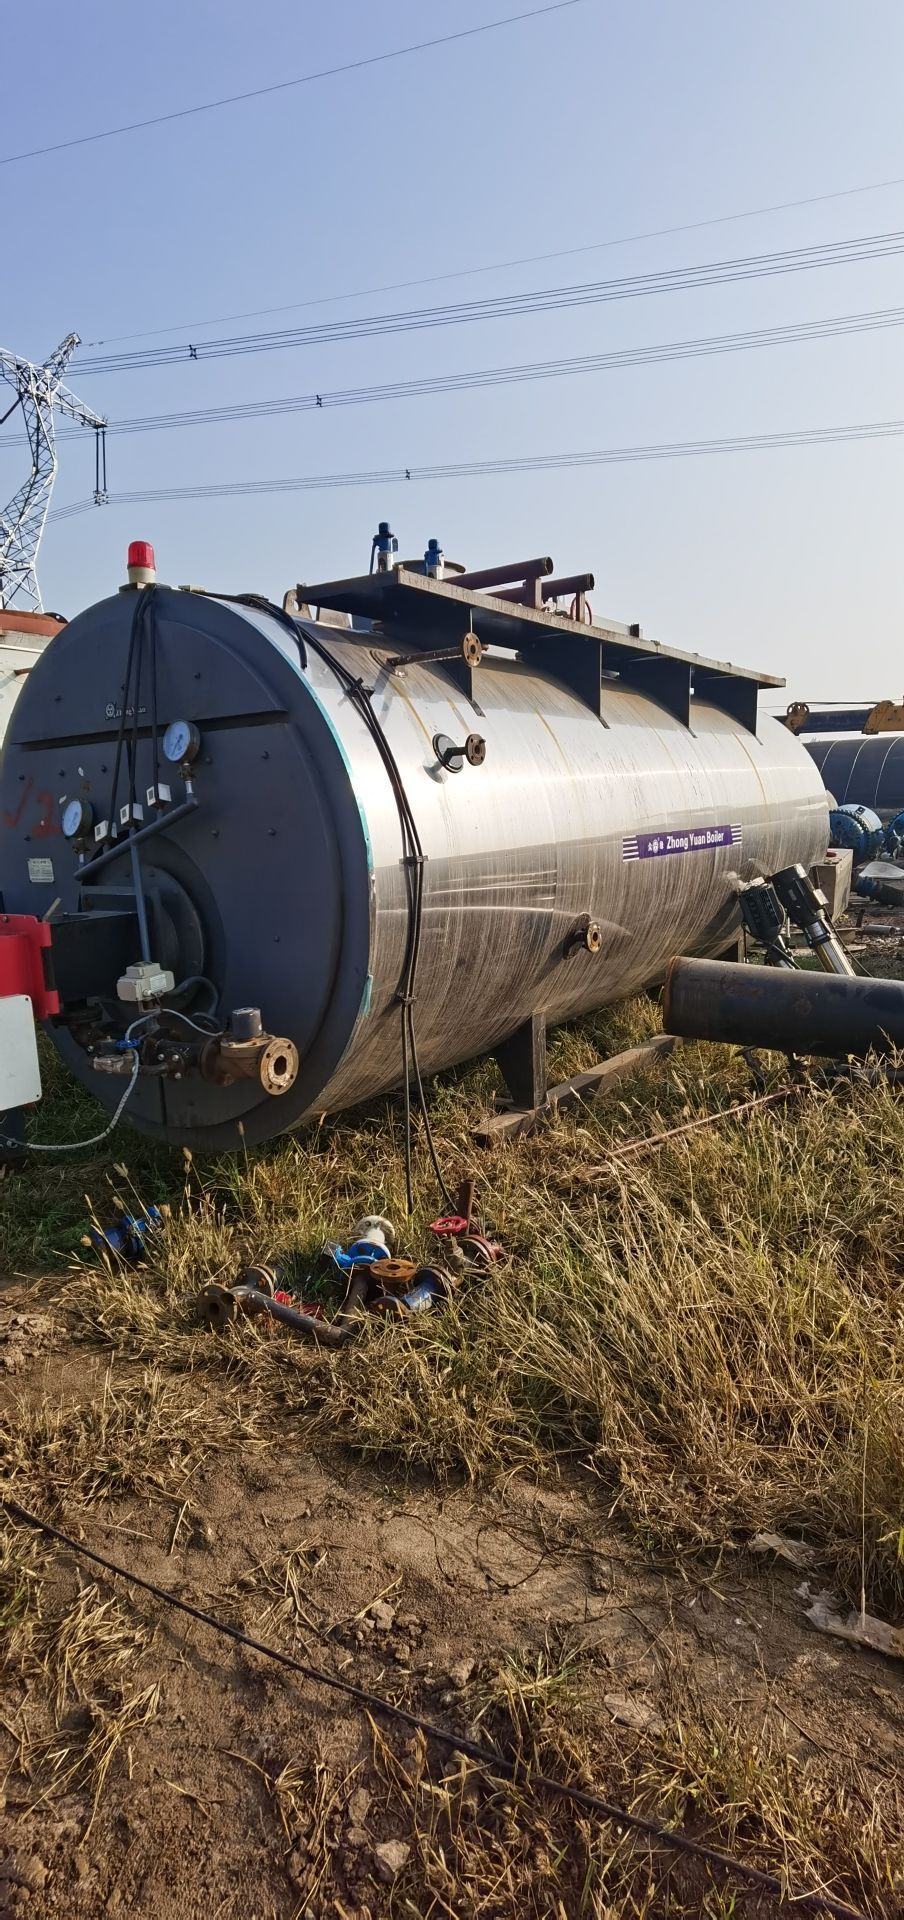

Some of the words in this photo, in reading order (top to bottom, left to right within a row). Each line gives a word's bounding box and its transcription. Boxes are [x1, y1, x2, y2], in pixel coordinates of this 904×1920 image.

[666, 836, 689, 850] Zhong
[689, 833, 706, 845] Yuan
[706, 831, 724, 843] Boiler
